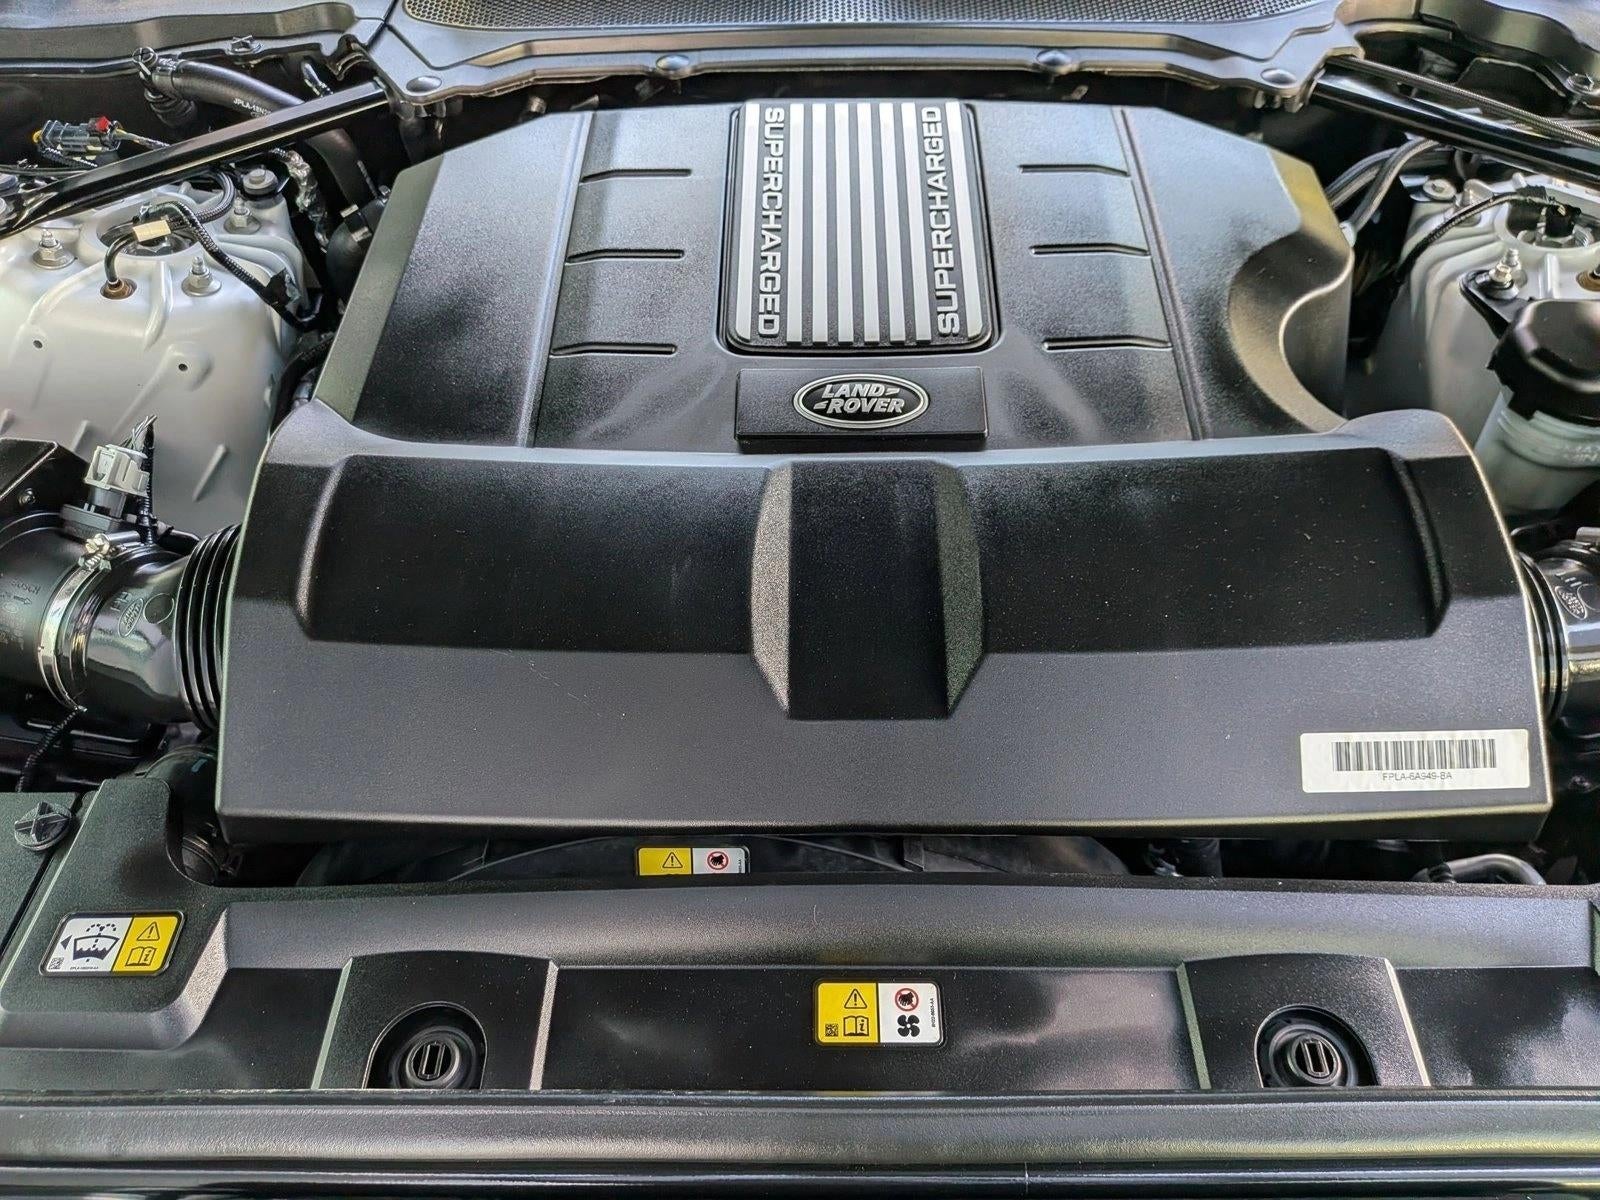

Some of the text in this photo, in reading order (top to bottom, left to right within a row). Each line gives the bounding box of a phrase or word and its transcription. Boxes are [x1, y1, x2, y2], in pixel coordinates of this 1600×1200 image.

[758, 106, 785, 336] SUPERCHARGED
[921, 106, 960, 336] SUPERCHARGED
[821, 383, 885, 399] LAND
[826, 398, 905, 414] ROVER
